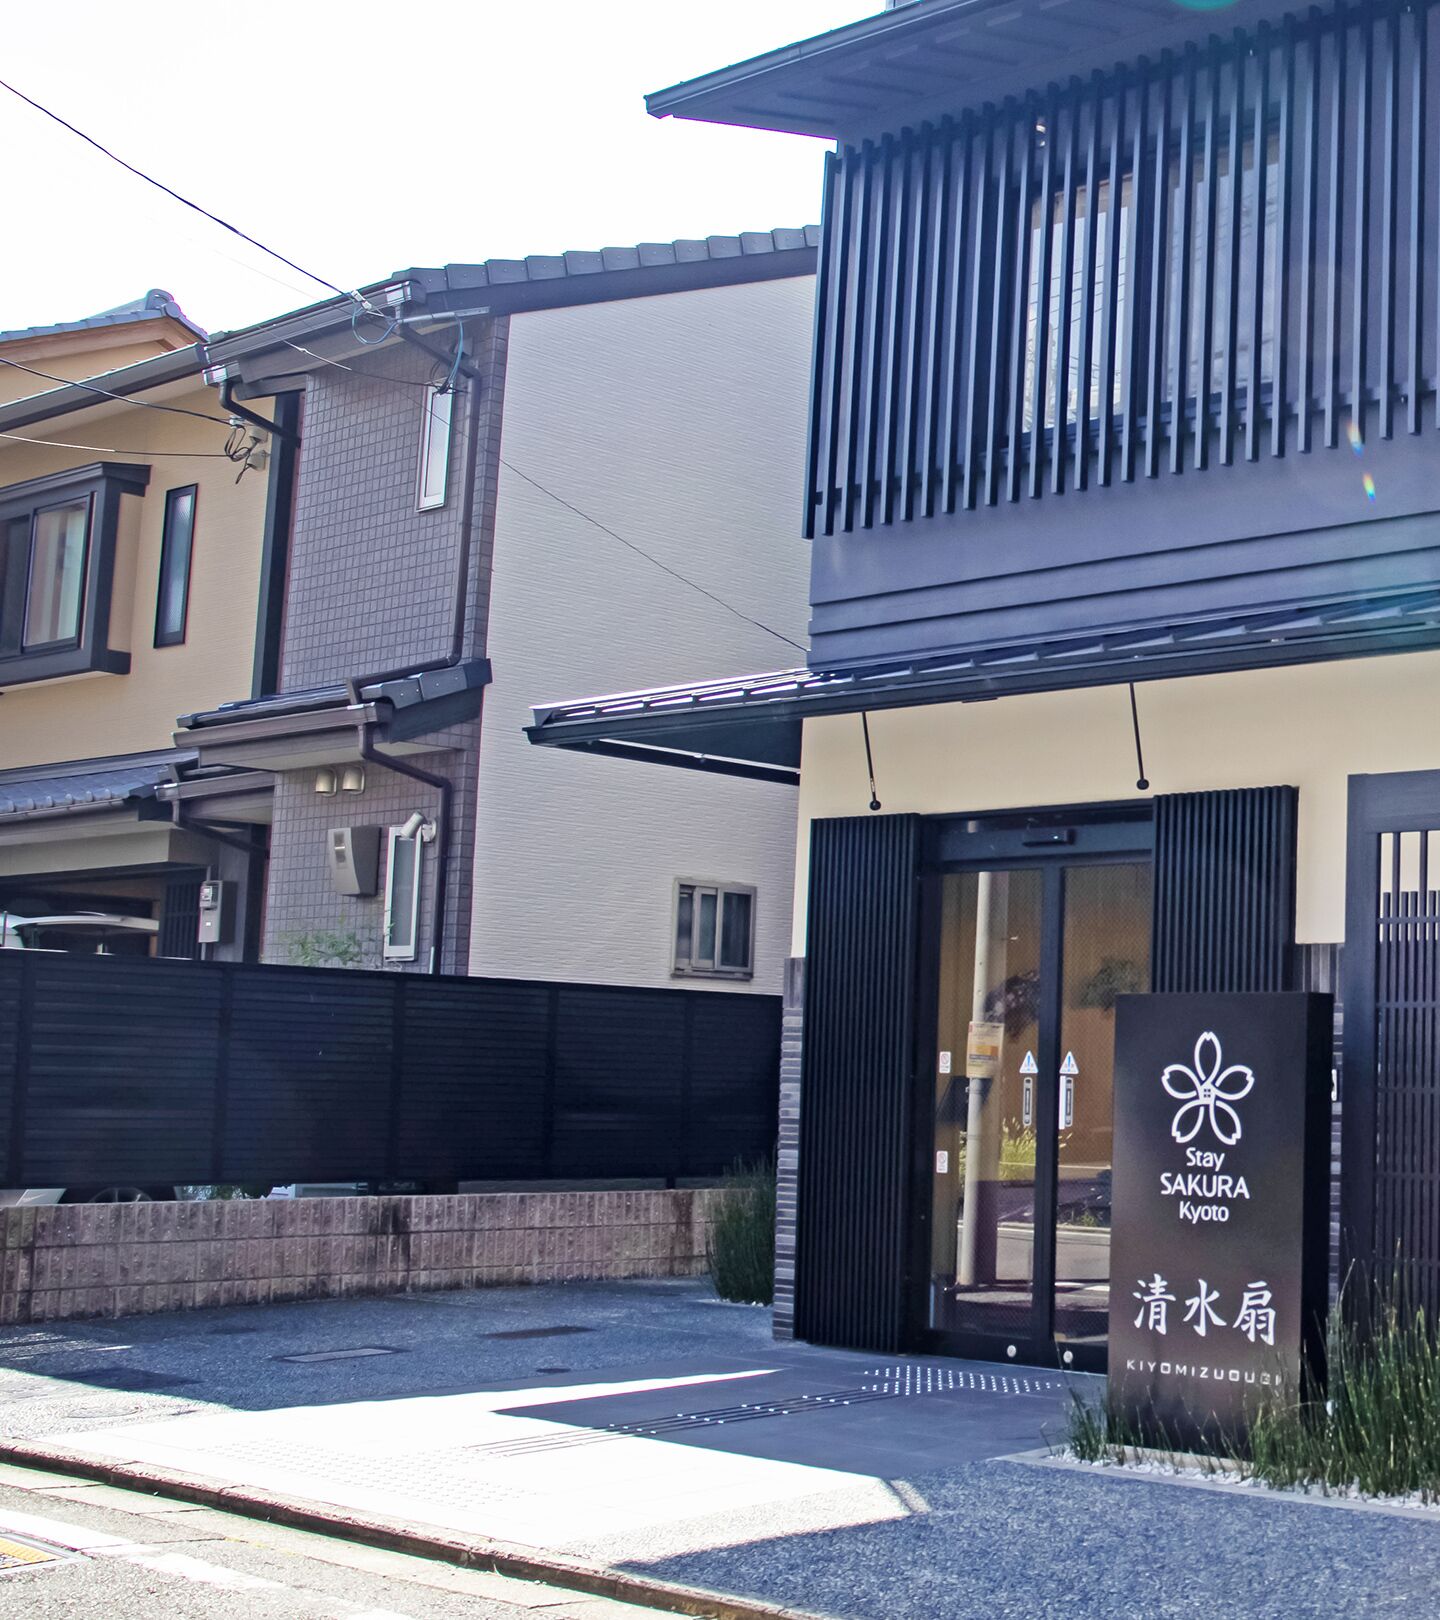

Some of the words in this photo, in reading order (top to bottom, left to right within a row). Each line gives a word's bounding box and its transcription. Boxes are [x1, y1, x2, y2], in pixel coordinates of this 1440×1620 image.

[1186, 1147, 1225, 1171] Stay
[1160, 1172, 1250, 1200] SAKURA
[1179, 1201, 1229, 1224] Kyoto
[1132, 1273, 1276, 1346] 清水扇
